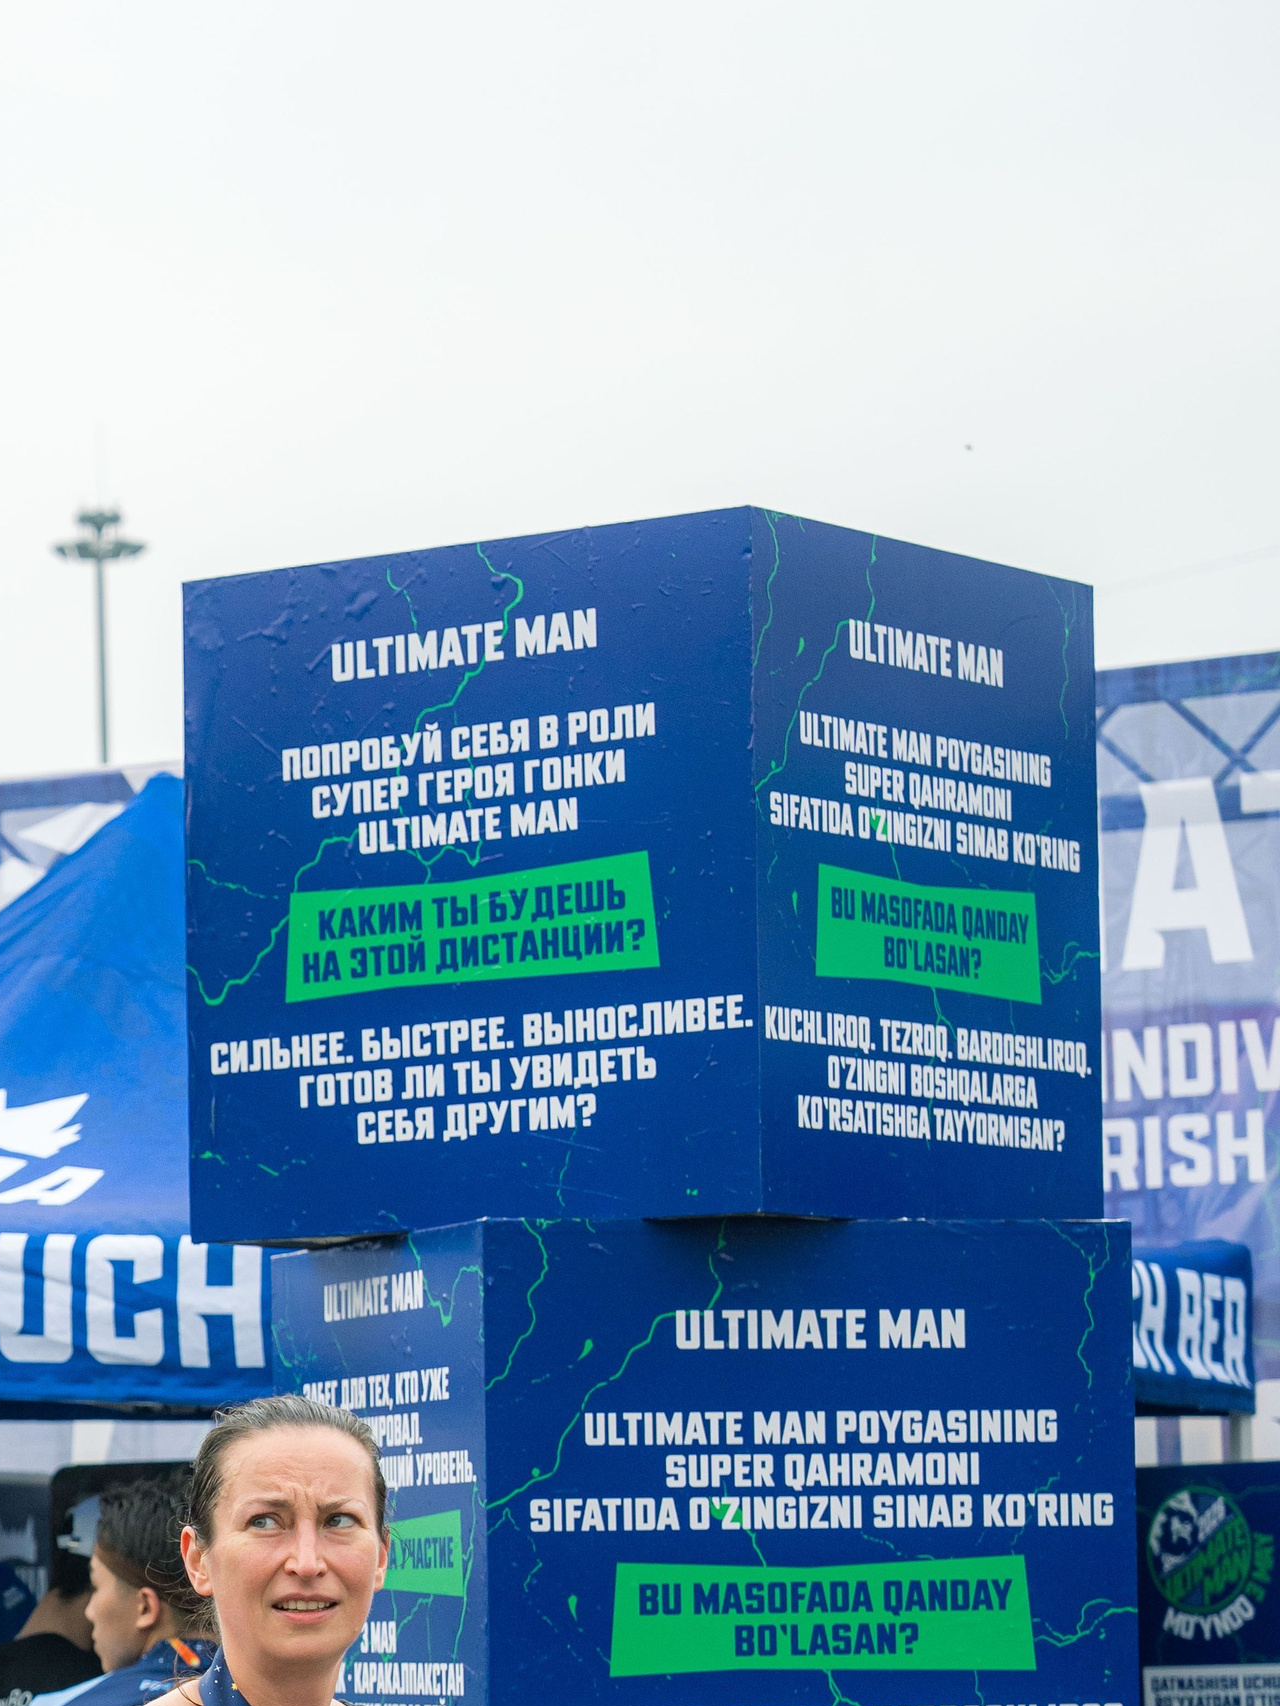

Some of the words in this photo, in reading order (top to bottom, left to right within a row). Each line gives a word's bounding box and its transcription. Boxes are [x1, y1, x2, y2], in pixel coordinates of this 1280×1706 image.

[331, 621, 504, 682] ULTIMATE
[516, 608, 597, 657] MAN
[849, 619, 952, 677] ULTIMATE
[958, 642, 1003, 687] MAN
[282, 722, 442, 781] ПОПРОБУЙ
[451, 719, 529, 760] СЕБЯ
[539, 715, 558, 749] В
[568, 703, 655, 745] РОЛИ
[800, 711, 887, 758] ULTIMATE
[893, 728, 931, 766] MAN
[937, 736, 1051, 787] POYGASINING
[312, 776, 408, 818] СУПЕР
[419, 763, 514, 805] ГЕРОЯ
[524, 749, 625, 793] ГОНКИ
[845, 762, 904, 803] SUPER
[909, 773, 1011, 821] QAHRAMONI
[359, 806, 501, 854] ULTIMATE
[511, 797, 578, 837] MAN
[770, 792, 854, 836] SIFATIDA
[957, 822, 1008, 861] SINAB
[319, 901, 422, 940] КАКИМ
[432, 894, 477, 928] ТЫ
[490, 879, 625, 922] БУДЕШЬ
[832, 887, 855, 920] BU
[862, 891, 957, 934] MASOFADA
[963, 906, 1028, 943] QANDAY
[303, 951, 340, 983] НА
[351, 935, 425, 978] ЭТОЙ
[436, 919, 644, 973] ДИСТАНЦИИ?
[211, 1032, 353, 1074] СИЛЬНЕЕ.
[362, 1017, 514, 1061] БЫСТРЕЕ.
[523, 995, 753, 1047] ВЫНОСЛИВЕЕ.
[765, 1006, 875, 1053] KUCHLIROQ.
[880, 1019, 952, 1062] TEZROQ.
[957, 1028, 1091, 1077] BARDOSHLIROQ.
[300, 1069, 392, 1108] ГОТОВ
[402, 1064, 444, 1099] ЛИ
[453, 1059, 500, 1094] ТЫ
[507, 1041, 656, 1090] УВИДЕТЬ
[911, 1065, 1037, 1108] BOSHQALARGA
[358, 1107, 434, 1144] СЕБЯ
[443, 1094, 596, 1142] ДРУГИМ?
[934, 1109, 1064, 1151] TAYYORMISAN?
[324, 1276, 389, 1322] ULTIMATE
[392, 1270, 423, 1312] MAN
[676, 1310, 866, 1349] ULTIMATE
[880, 1309, 965, 1348] MAN
[1175, 1267, 1253, 1390] BER
[340, 1377, 366, 1411] ДЛЯ
[395, 1370, 419, 1404] КТО
[421, 1367, 450, 1402] УЖЕ
[585, 1412, 743, 1445] ULTIMATE
[754, 1411, 825, 1444] MAN
[837, 1410, 1057, 1443] POYGASINING
[416, 1450, 477, 1486] УРОВЕНЬ.
[666, 1454, 774, 1487] SUPER
[785, 1453, 979, 1490] QAHRAMONI
[530, 1498, 679, 1531] SIFATIDA
[874, 1495, 972, 1527] SINAB
[399, 1537, 454, 1569] УЧАСТИЕ
[639, 1584, 681, 1615] BU
[694, 1581, 873, 1614] MASOFADA
[884, 1579, 1012, 1616] QANDAY
[371, 1620, 397, 1654] МАЯ
[354, 1662, 464, 1696] КАРАКАЛПАКСТАН
